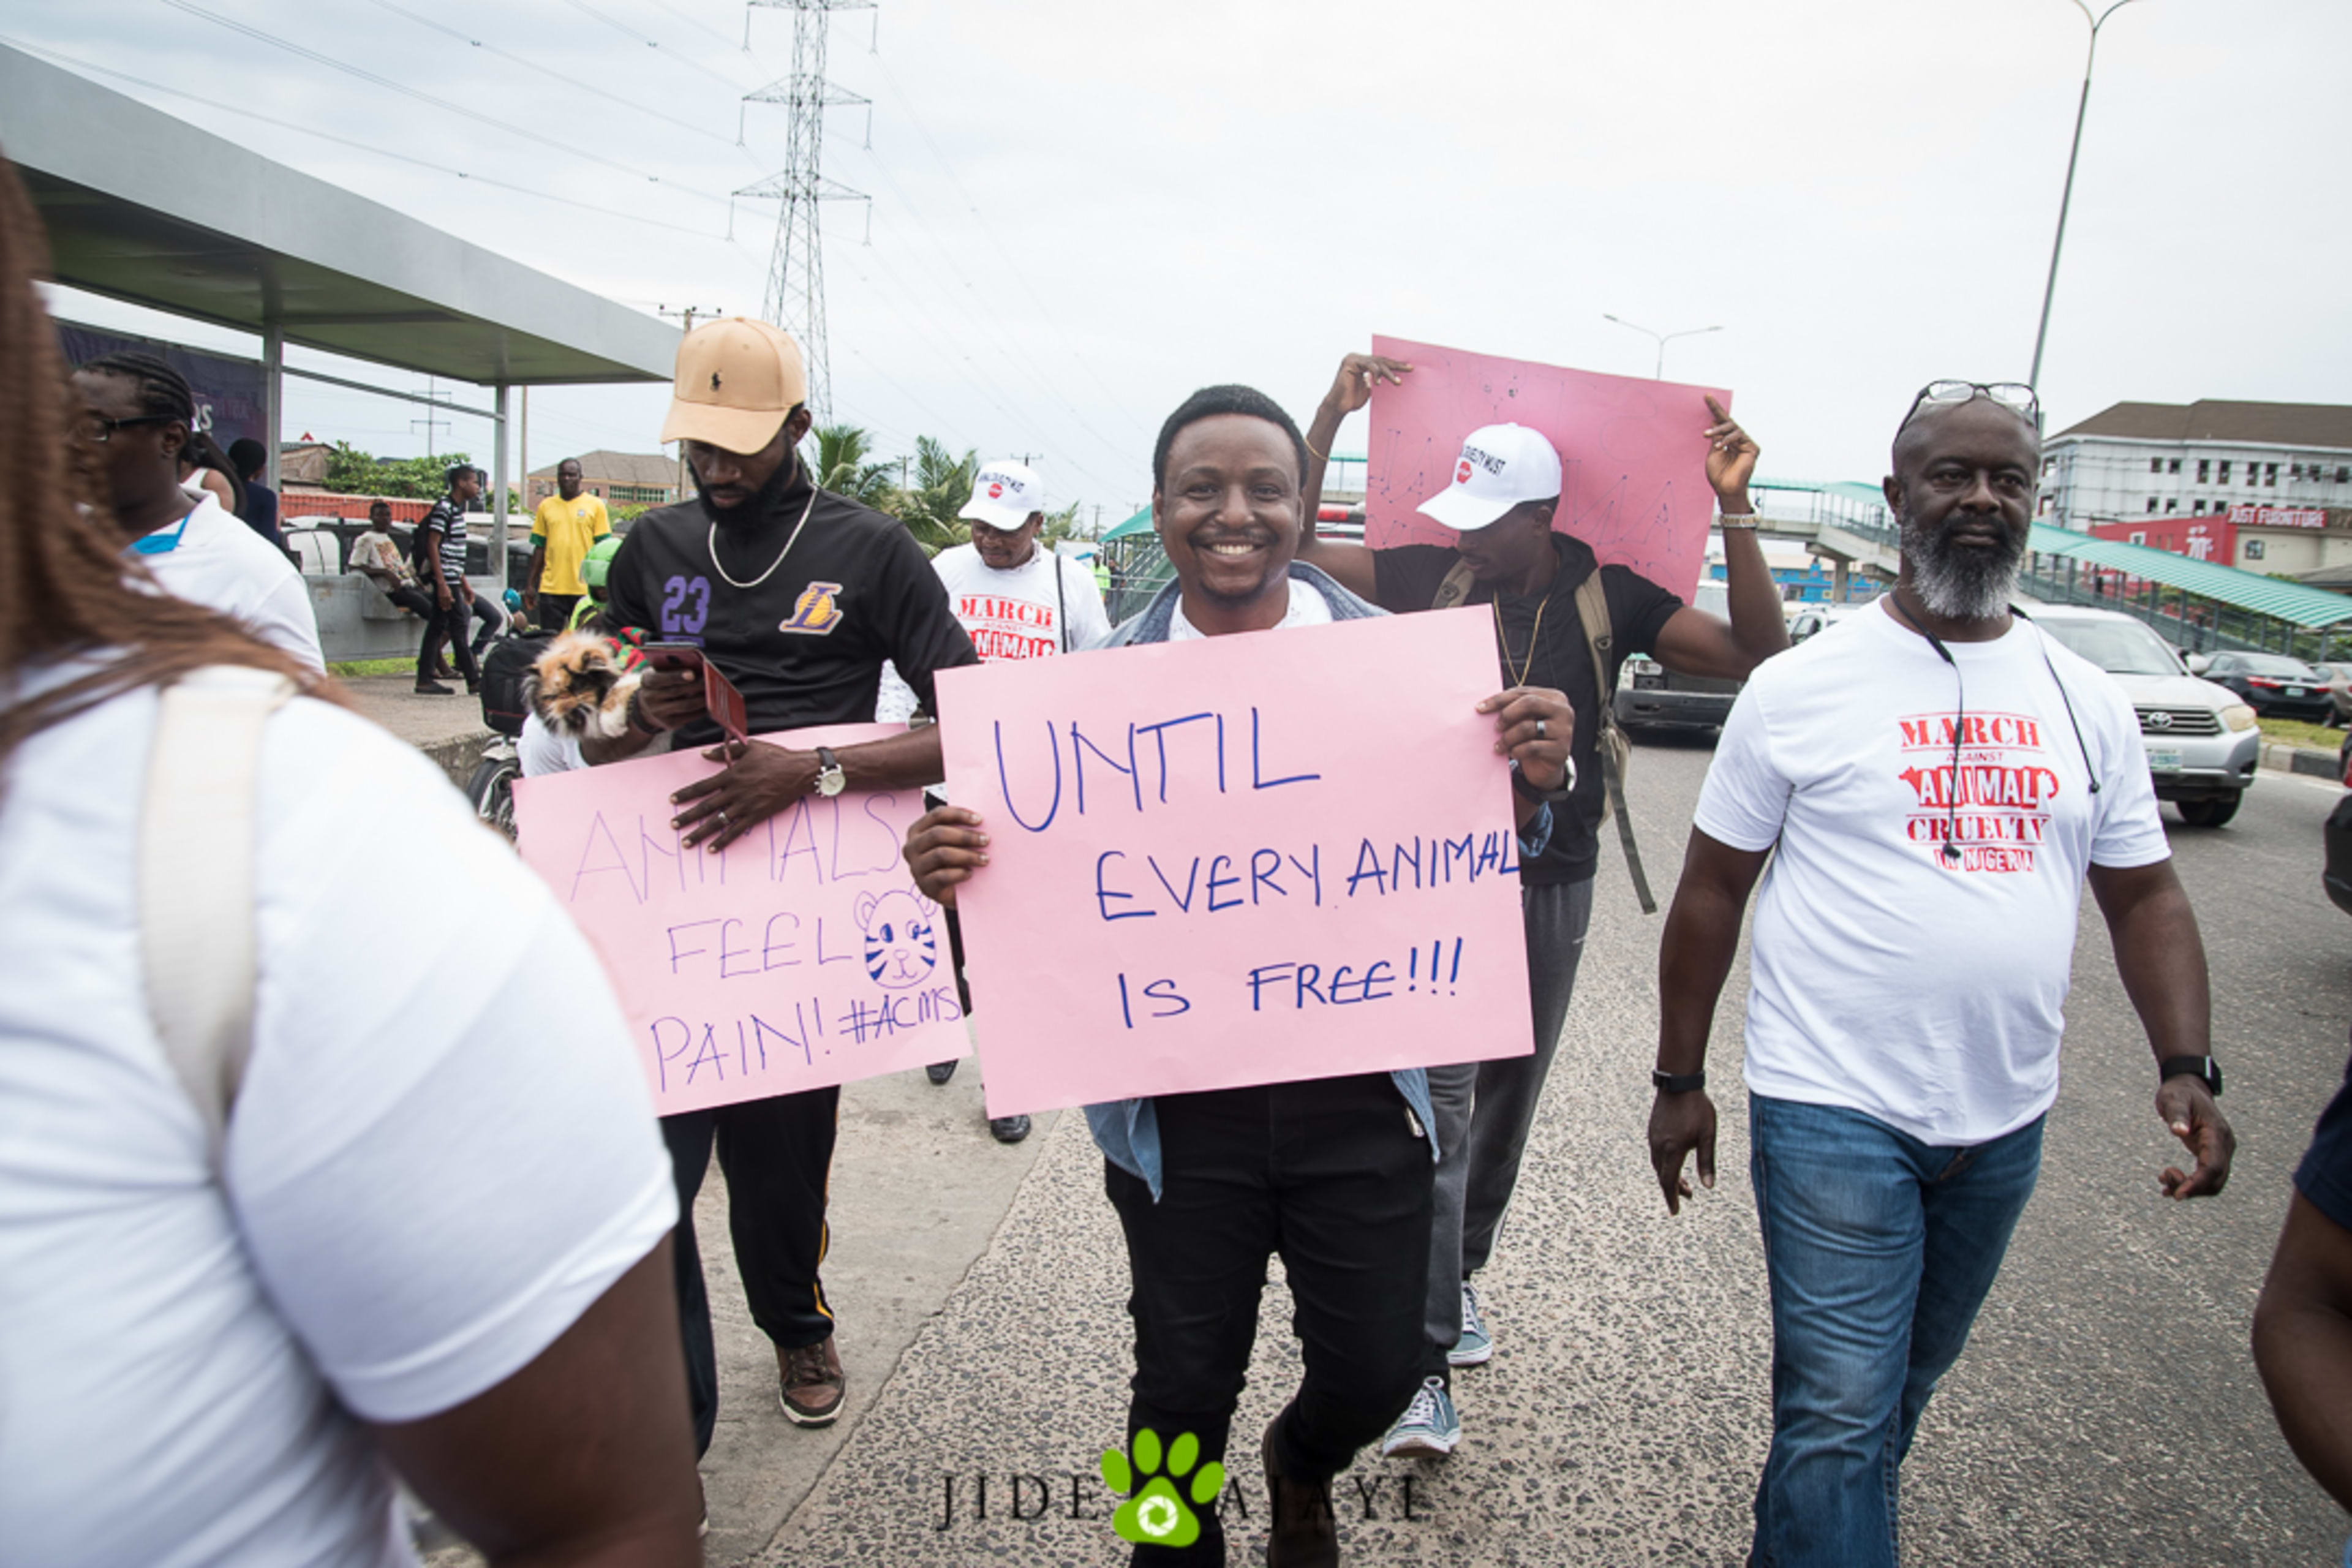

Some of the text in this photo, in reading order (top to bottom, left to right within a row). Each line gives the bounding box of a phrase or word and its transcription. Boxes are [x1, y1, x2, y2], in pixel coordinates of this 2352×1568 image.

[2256, 508, 2325, 527] FURNITURE
[662, 575, 710, 633] 23
[957, 599, 1051, 626] MARCH
[974, 630, 1043, 658] NIMAL
[1899, 717, 2040, 747] MARCH
[994, 706, 1321, 832] UNTIL
[1919, 767, 2037, 805] ANIMAL
[1907, 816, 2049, 842] CRUELTY
[1096, 830, 1521, 921] EVERY ANIMAL
[667, 912, 853, 979] FEEL
[1118, 937, 1463, 1029] IS FREE!!!
[650, 986, 962, 1093] PAIN! #ACMS
